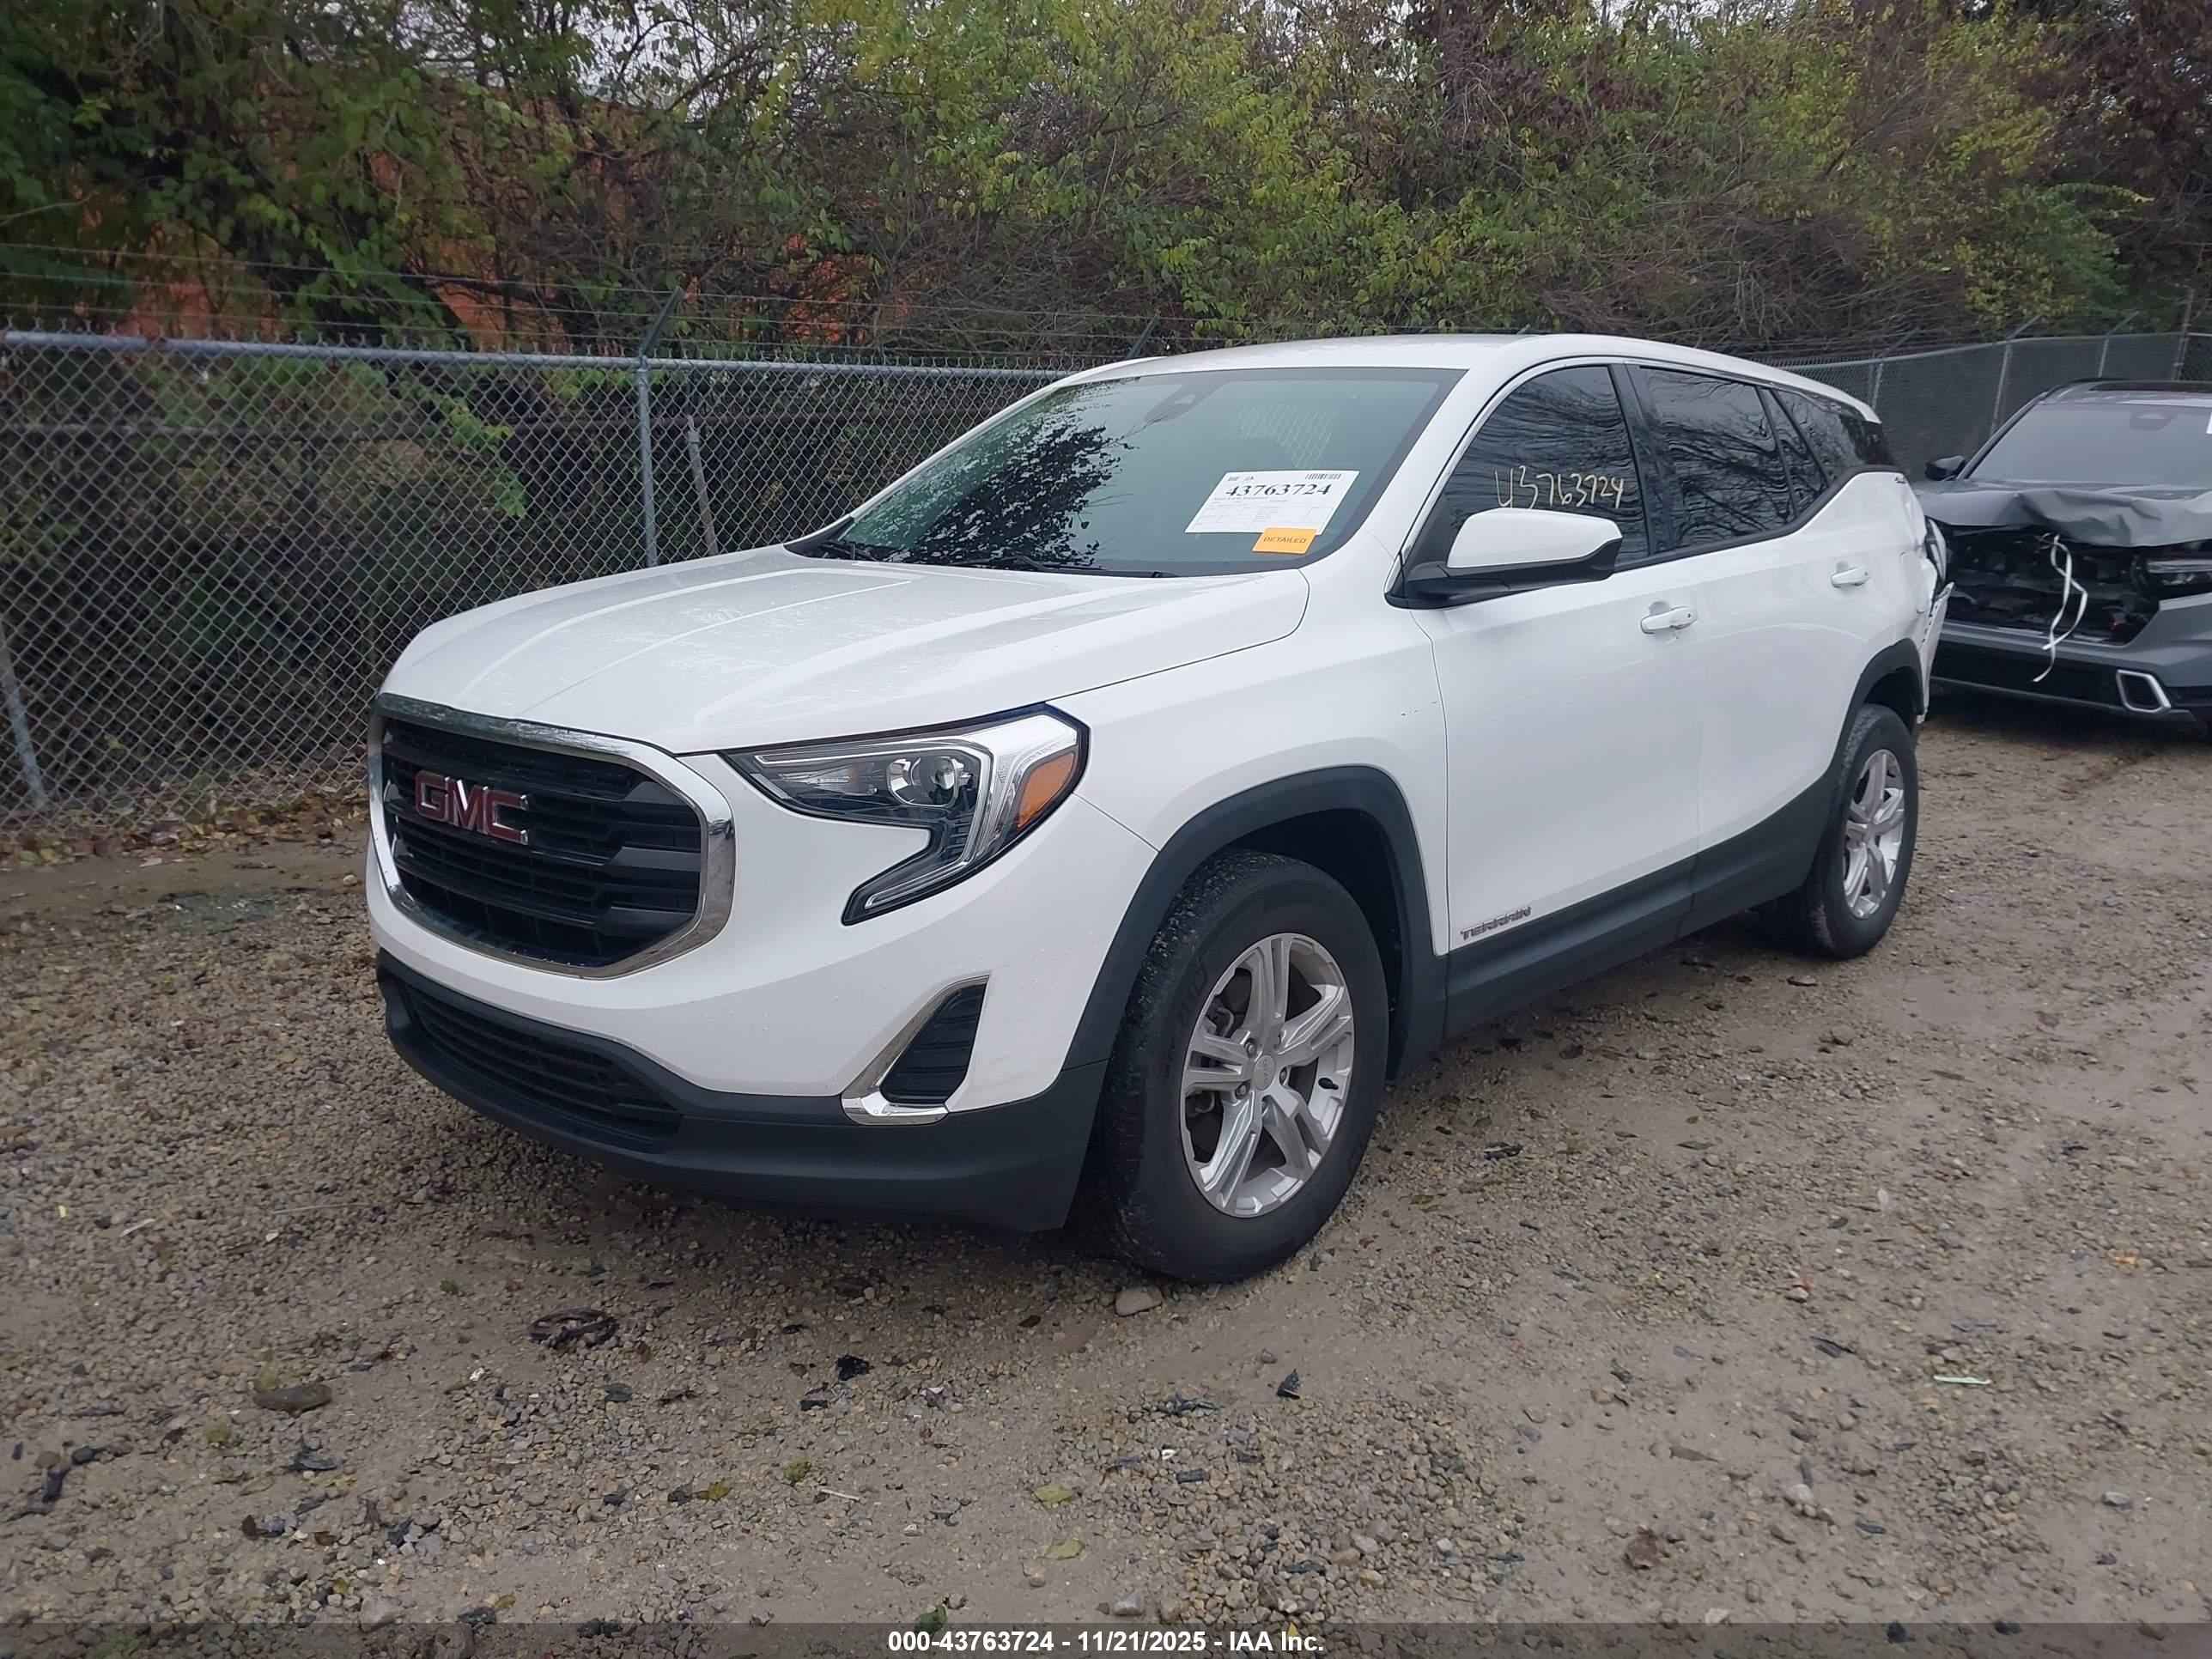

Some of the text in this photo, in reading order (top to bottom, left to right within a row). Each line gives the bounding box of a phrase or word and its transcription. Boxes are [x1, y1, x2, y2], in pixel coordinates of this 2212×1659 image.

[1225, 483, 1332, 496] 43763724
[415, 769, 529, 846] GMC
[1460, 906, 1532, 941] TERRAIN
